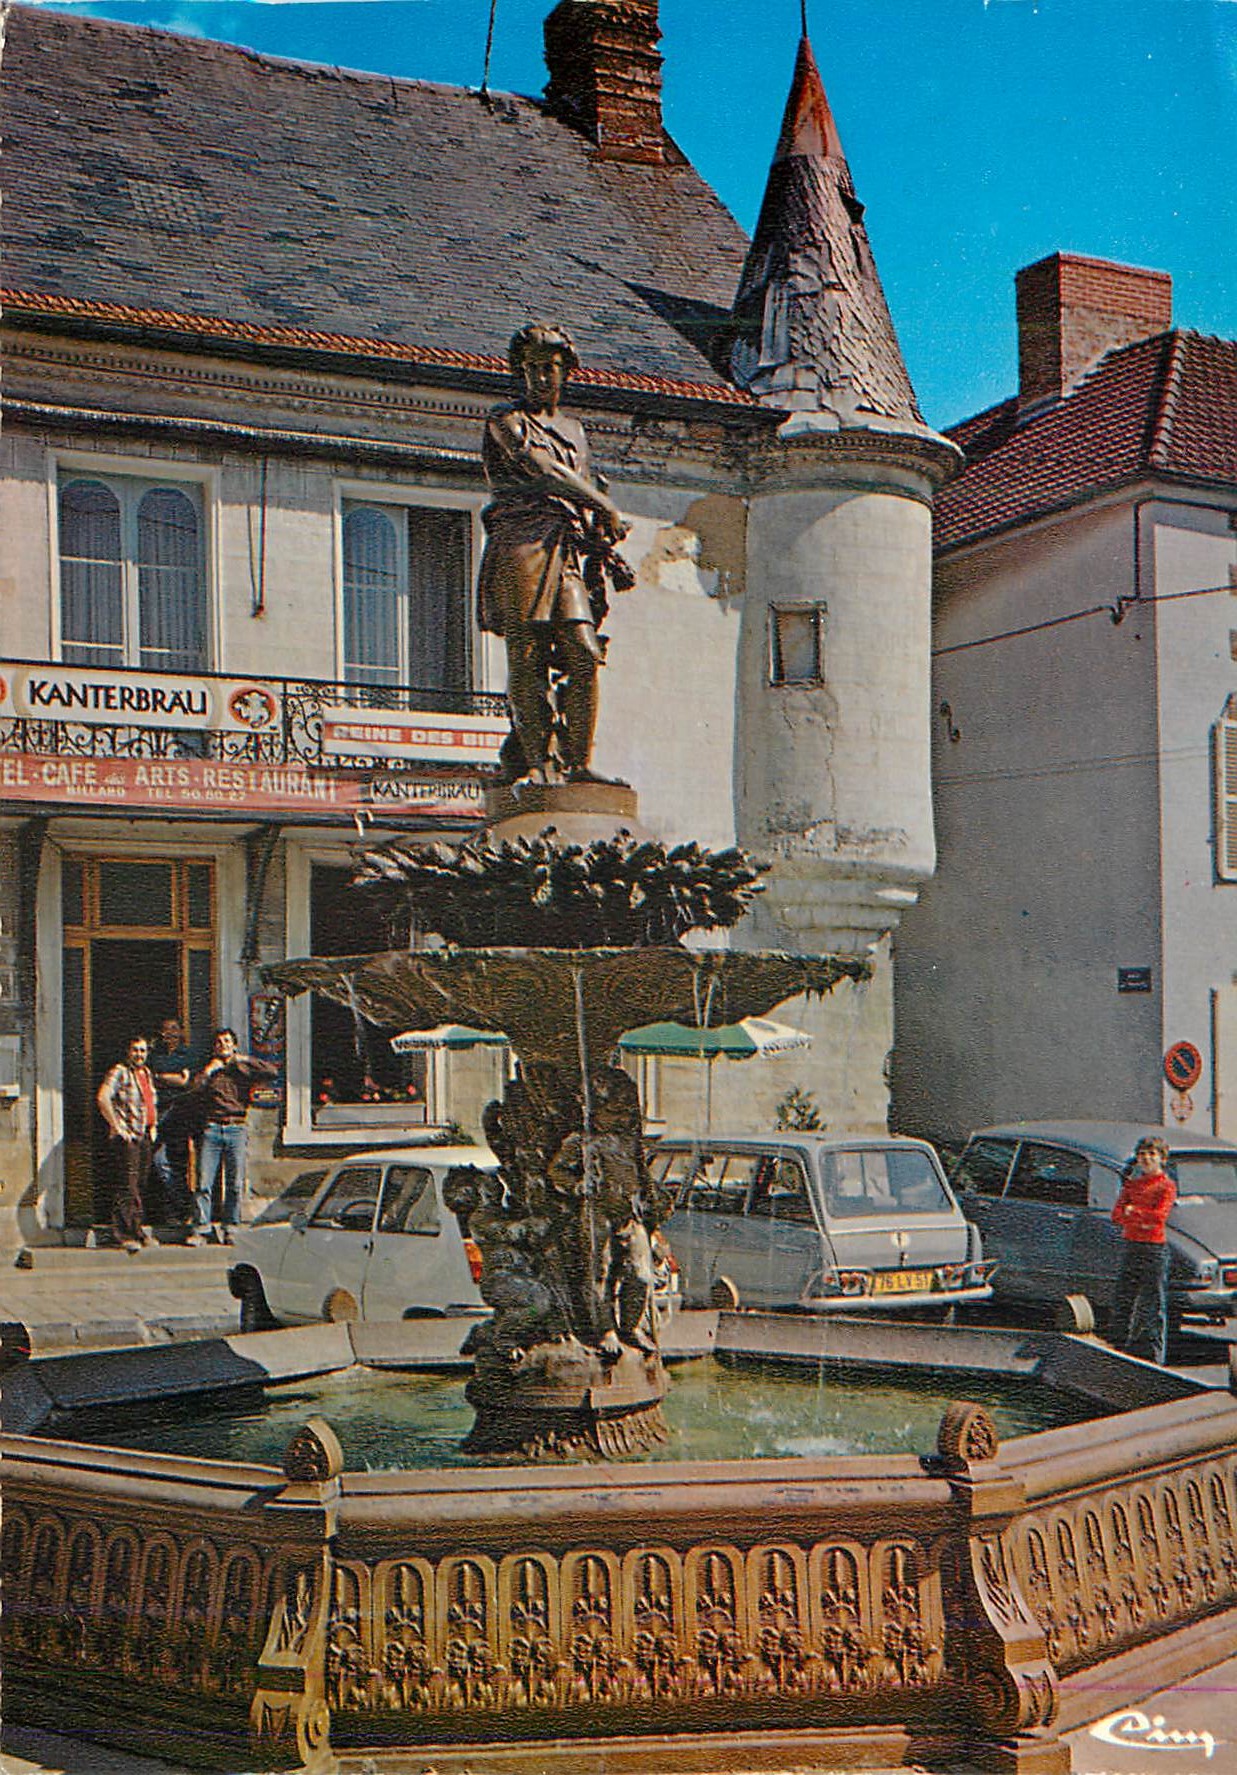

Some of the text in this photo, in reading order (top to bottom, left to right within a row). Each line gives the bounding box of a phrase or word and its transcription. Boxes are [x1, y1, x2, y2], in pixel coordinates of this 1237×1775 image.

[29, 680, 207, 715] KANTERBRÄU
[333, 725, 505, 747] REINE DES BIE
[134, 765, 190, 787] ARTS
[203, 767, 337, 802] RESTAURANT
